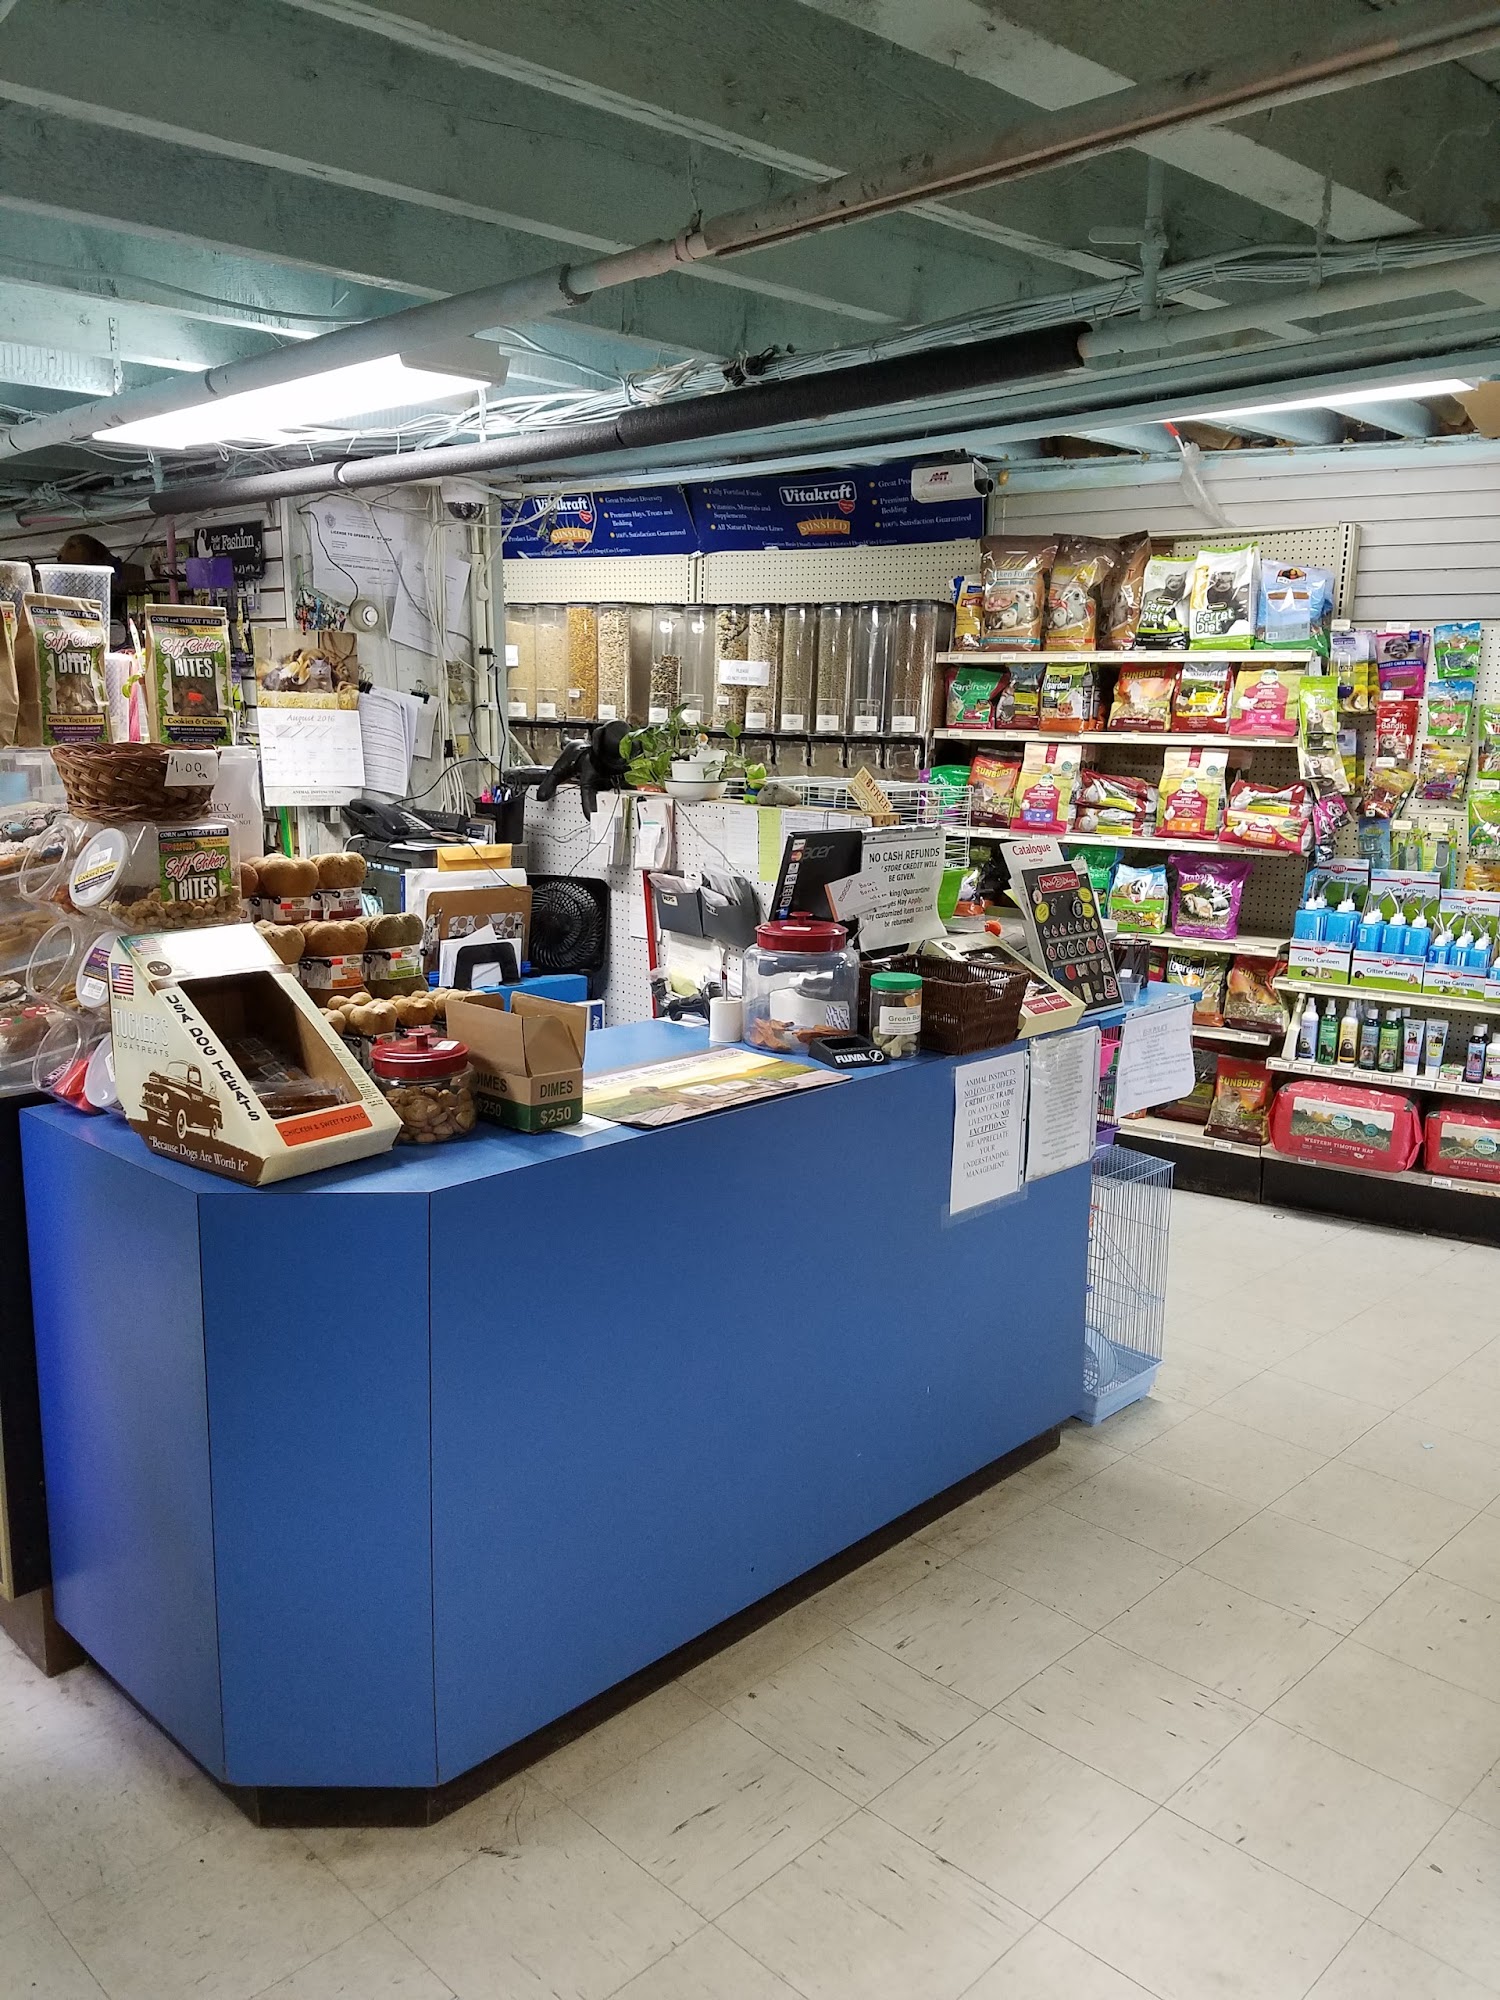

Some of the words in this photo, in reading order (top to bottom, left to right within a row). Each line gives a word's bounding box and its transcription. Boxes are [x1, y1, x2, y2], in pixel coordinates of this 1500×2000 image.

[878, 479, 896, 488] Great
[639, 495, 663, 503] Diversity
[708, 488, 722, 496] Fully
[746, 489, 762, 497] Foods
[783, 484, 852, 502] Vitakraft
[880, 496, 909, 505] Premium
[610, 511, 632, 519] Premium
[664, 508, 673, 516] and
[761, 504, 771, 512] and
[882, 506, 908, 515] Bedding
[612, 520, 633, 528] Bedding
[799, 519, 848, 532] SUNSEED
[900, 517, 935, 527] Satisfaction
[935, 513, 972, 524] Guaranteed
[629, 530, 656, 538] Satisfaction
[657, 528, 686, 537] Guaranteed
[716, 523, 725, 531] All
[726, 523, 747, 531] Natural
[748, 523, 768, 532] Product
[768, 524, 784, 532] Lines
[221, 531, 255, 550] Fashion
[551, 528, 592, 541] SUNSEED
[32, 606, 50, 614] CORN
[60, 610, 81, 618] WHEAT
[82, 611, 99, 619] FREE!
[1197, 608, 1236, 622] Ferret
[1196, 622, 1222, 634] Diet
[43, 630, 69, 654] Soft
[69, 630, 102, 649] Bakes
[160, 638, 186, 659] Soft
[186, 636, 222, 654] Bakes
[58, 653, 91, 675] BITES
[174, 658, 213, 678] BITES
[1121, 669, 1166, 681] SUNBURST
[48, 716, 65, 724] Greek
[66, 716, 88, 724] Yogurt
[286, 714, 315, 726] August
[316, 714, 335, 722] 2016
[1380, 720, 1408, 730] Bandits
[171, 756, 202, 773] $1.00
[975, 766, 1014, 778] SUNBURST
[160, 830, 177, 838] CORN
[803, 845, 835, 860] acer
[869, 852, 881, 863] NO
[882, 850, 904, 862] CASH
[905, 847, 940, 860] REFUNDS
[1012, 843, 1052, 856] Catalogue
[165, 856, 191, 881] Soft
[192, 850, 227, 872] Bakes
[883, 863, 902, 872] STORE
[902, 862, 923, 871] CREDIT
[924, 860, 938, 868] WILL
[888, 874, 896, 882] BE
[896, 872, 916, 882] GIVEN.
[179, 876, 218, 901] BITES
[875, 908, 902, 919] customized
[904, 906, 915, 914] item
[924, 904, 933, 912] not
[884, 920, 890, 928] be
[891, 916, 914, 926] returned!
[1298, 955, 1316, 963] Critter
[1316, 957, 1340, 965] Canteen
[1172, 962, 1205, 976] garden
[1366, 967, 1385, 975] Critter
[1385, 970, 1409, 978] Canteen
[1434, 978, 1451, 986] Critter
[1452, 980, 1475, 988] Canteen
[888, 1014, 911, 1022] Green
[112, 1008, 169, 1047] TUCKER'S
[117, 1041, 134, 1050] USA
[136, 1044, 170, 1058] TREATS
[166, 994, 194, 1024] USA
[189, 1028, 218, 1056] DOG
[212, 1060, 260, 1120] TREATS
[835, 1053, 869, 1064] FLUVAL
[965, 1074, 988, 1088] ANIMAL
[988, 1068, 1016, 1082] INSTINCTS
[1219, 1074, 1265, 1088] SUNBURST
[540, 1080, 574, 1099] DIMES
[964, 1088, 974, 1098] NO
[974, 1084, 995, 1097] LONGER
[995, 1078, 1017, 1090] OFFERS
[964, 1095, 986, 1108] CREDIT
[986, 1093, 994, 1102] OR
[995, 1088, 1015, 1100] TRADE
[478, 1099, 502, 1118] $250
[968, 1108, 976, 1117] ON
[977, 1105, 990, 1116] ANY
[990, 1102, 1002, 1112] FISH
[1002, 1100, 1011, 1108] OR
[1001, 1108, 1010, 1118] NO
[540, 1106, 572, 1126] $250
[282, 1123, 312, 1138] CHICKEN
[320, 1118, 341, 1130] SWEET
[341, 1112, 367, 1127] POTATO
[966, 1140, 976, 1148] WE
[976, 1130, 1009, 1146] APPRECIATE
[1304, 1136, 1333, 1148] WESTERN
[1333, 1142, 1360, 1153] TIMOTHY
[1361, 1146, 1374, 1155] HAY
[979, 1144, 996, 1155] YOUR
[179, 1144, 198, 1163] Dogs
[200, 1149, 213, 1164] Are
[214, 1152, 236, 1170] Worth
[1453, 1158, 1478, 1168] WESTERN
[966, 1160, 1006, 1178] MANAGEMENT
